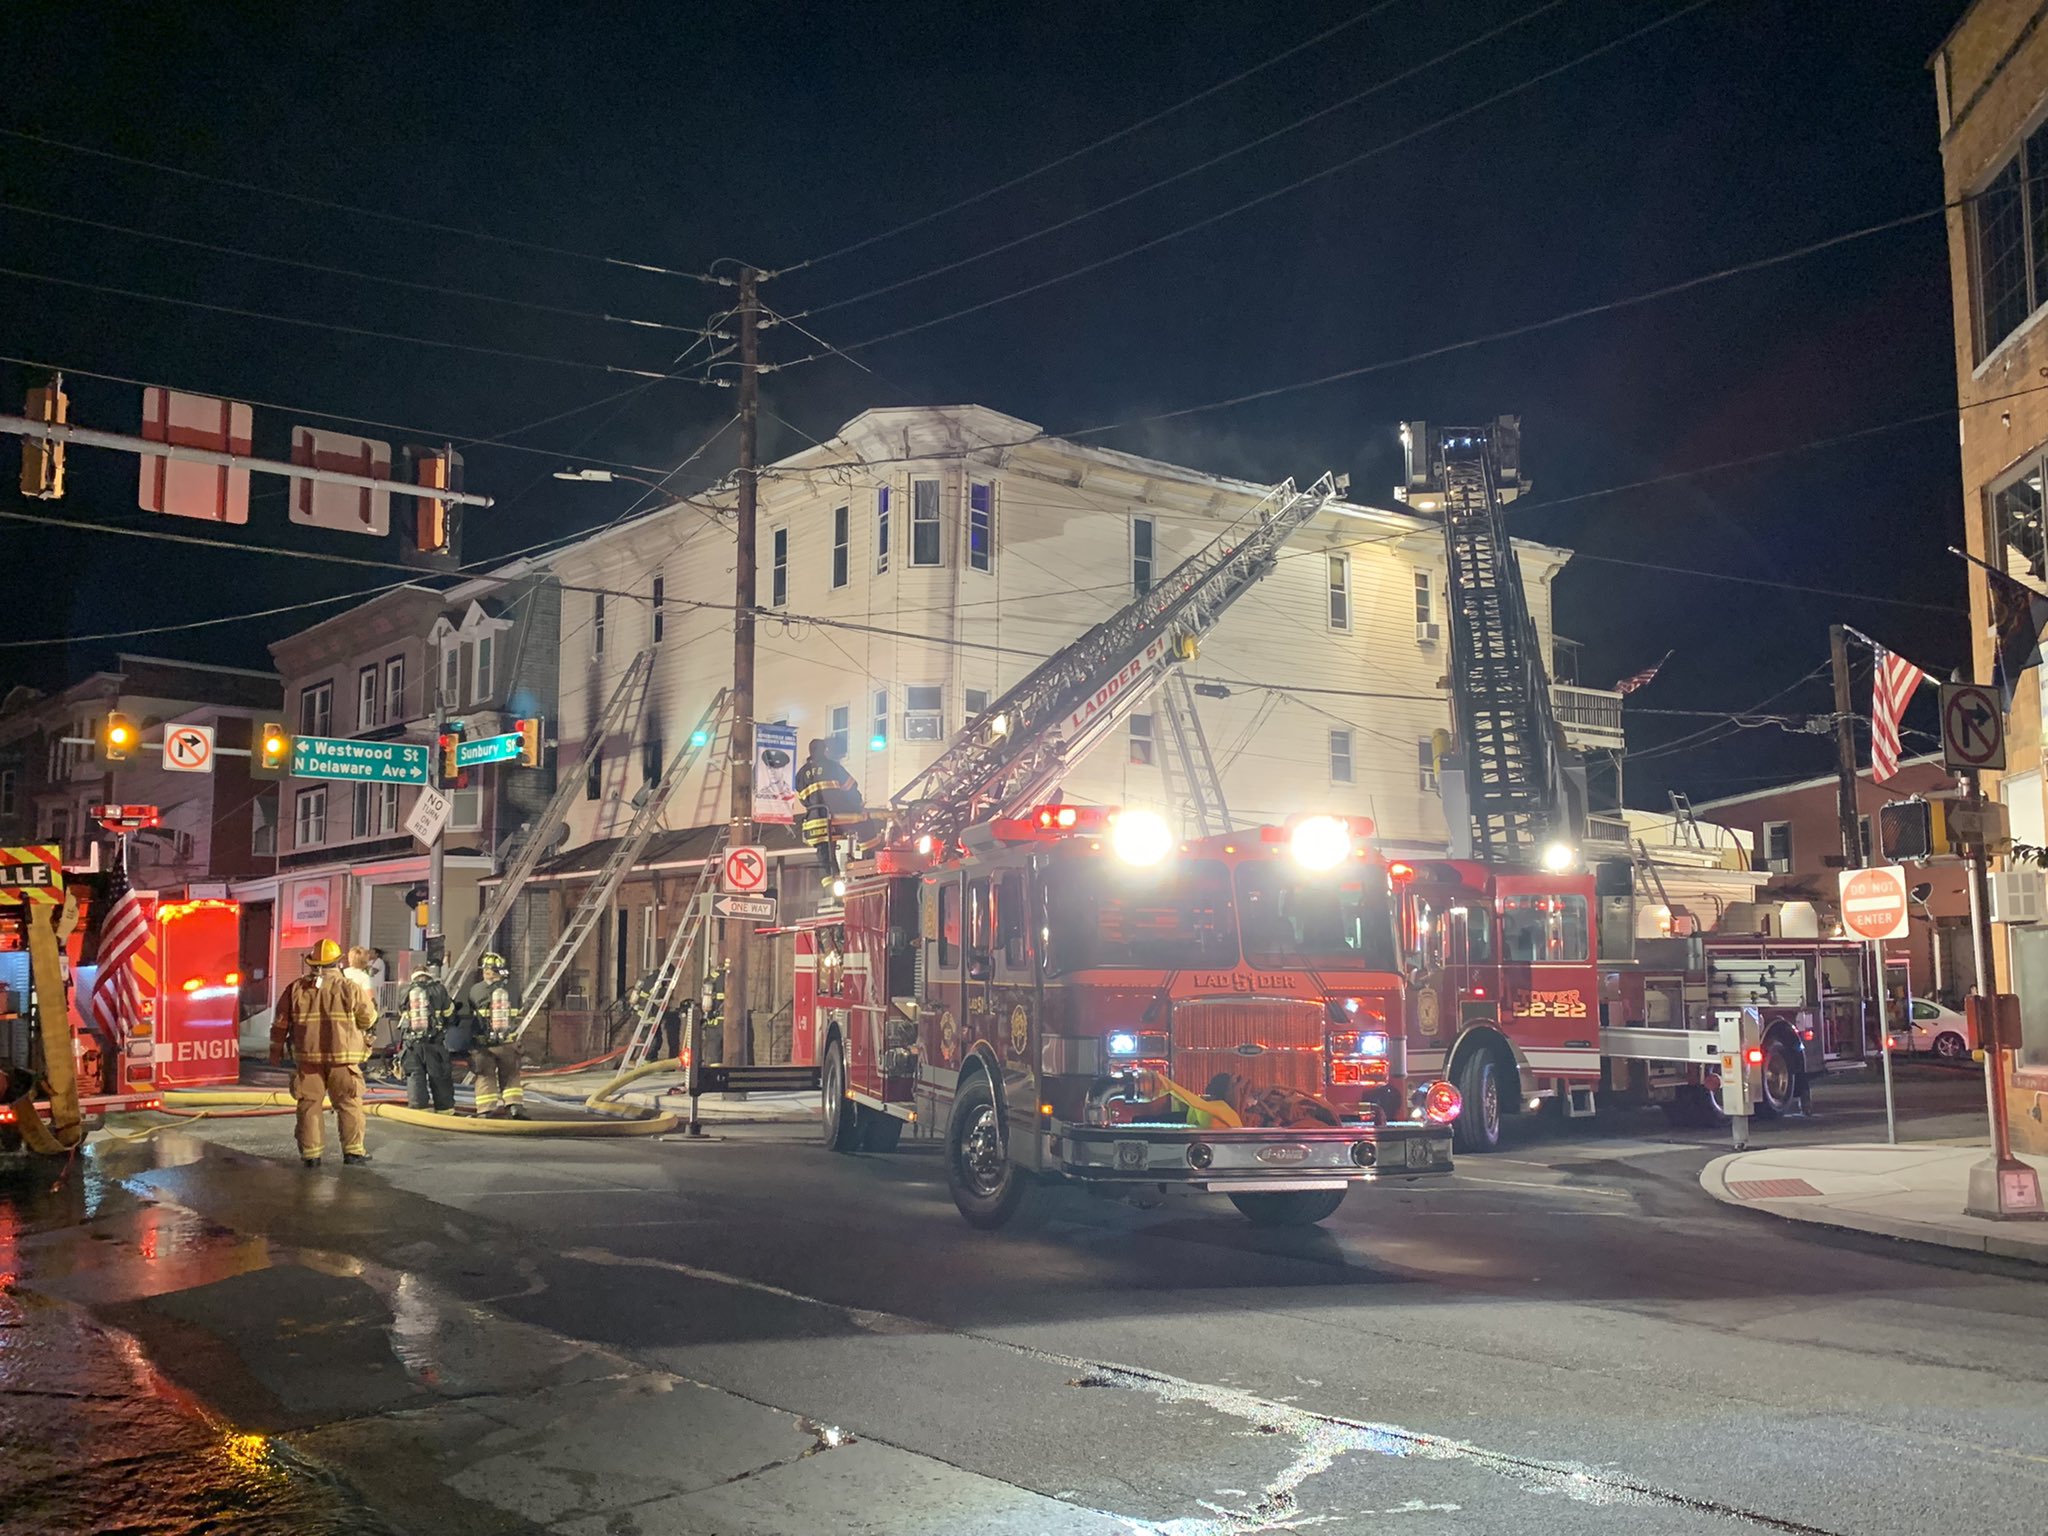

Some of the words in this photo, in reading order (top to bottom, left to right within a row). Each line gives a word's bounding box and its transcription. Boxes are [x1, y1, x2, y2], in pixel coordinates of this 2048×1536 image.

[1072, 659, 1142, 728] LADDER
[1146, 637, 1165, 660] 51
[314, 741, 393, 760] Westwood
[403, 748, 419, 762] St
[460, 743, 499, 761] Sunbury
[505, 738, 516, 752] St
[294, 757, 305, 770] N
[309, 758, 373, 775] Delaware
[382, 762, 407, 778] Ave
[427, 793, 444, 811] NO
[421, 803, 440, 821] TURN
[414, 822, 427, 837] RED
[420, 815, 431, 828] ON
[1850, 883, 1866, 896] DO
[1871, 881, 1894, 894] NOT
[731, 902, 748, 912] ONE
[751, 904, 768, 913] WAY
[1857, 912, 1893, 926] ENTER
[1517, 988, 1581, 1005] TOWER
[1513, 1002, 1587, 1018] 52-22
